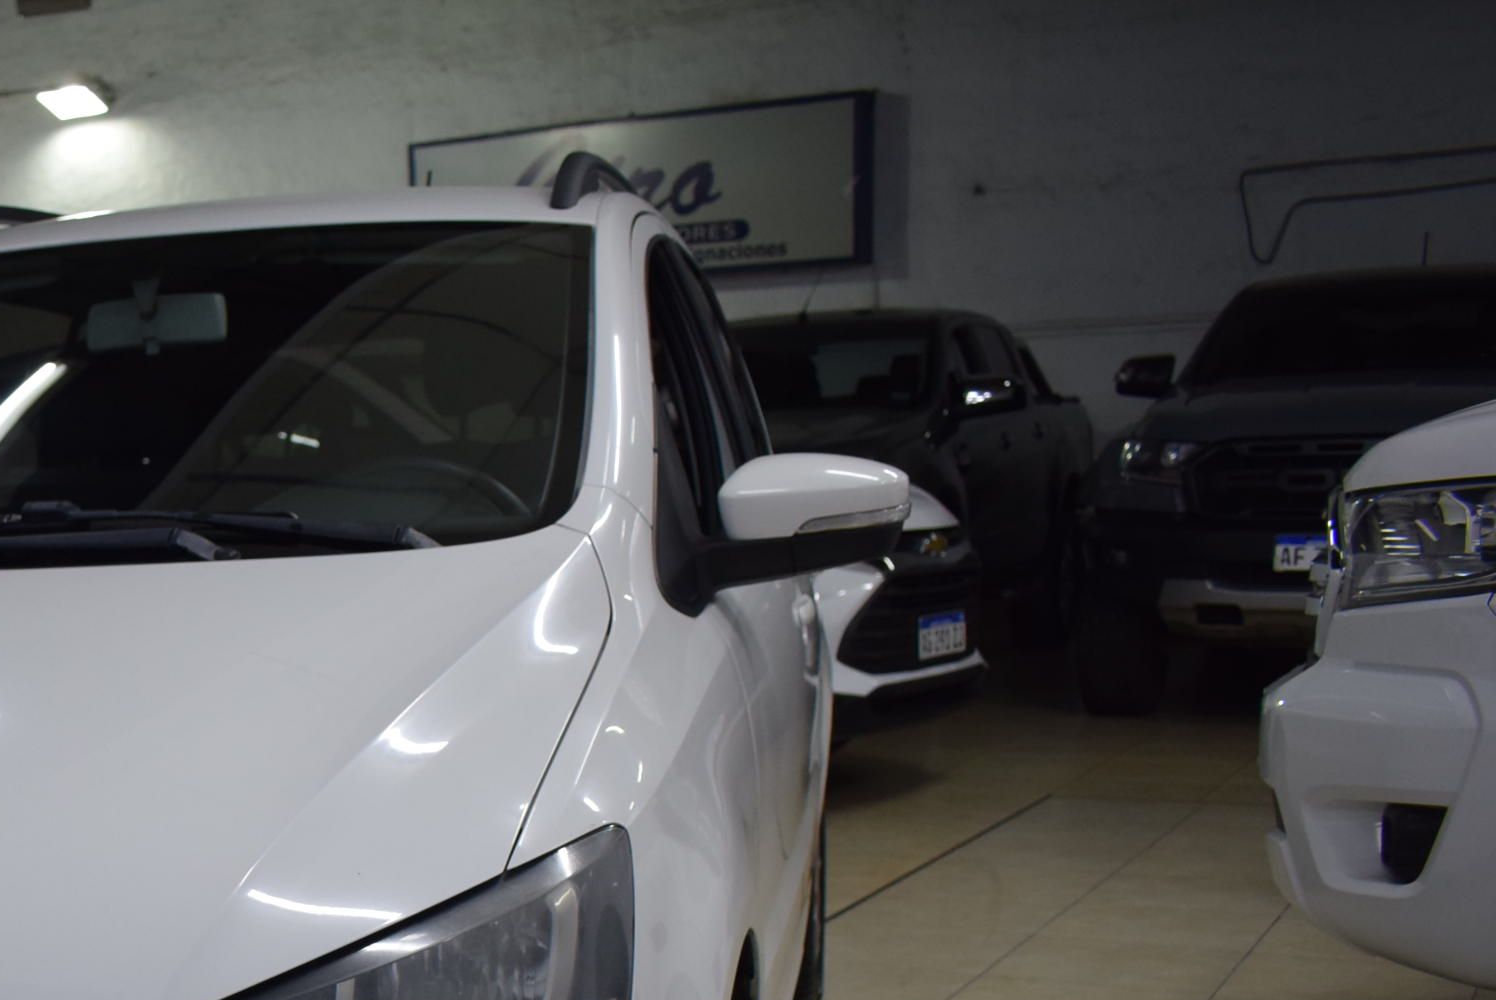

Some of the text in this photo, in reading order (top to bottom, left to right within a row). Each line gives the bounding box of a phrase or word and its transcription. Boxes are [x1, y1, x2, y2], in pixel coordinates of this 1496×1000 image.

[678, 223, 738, 243] ORES
[695, 241, 788, 265] gnaciones
[1280, 547, 1305, 566] AF
